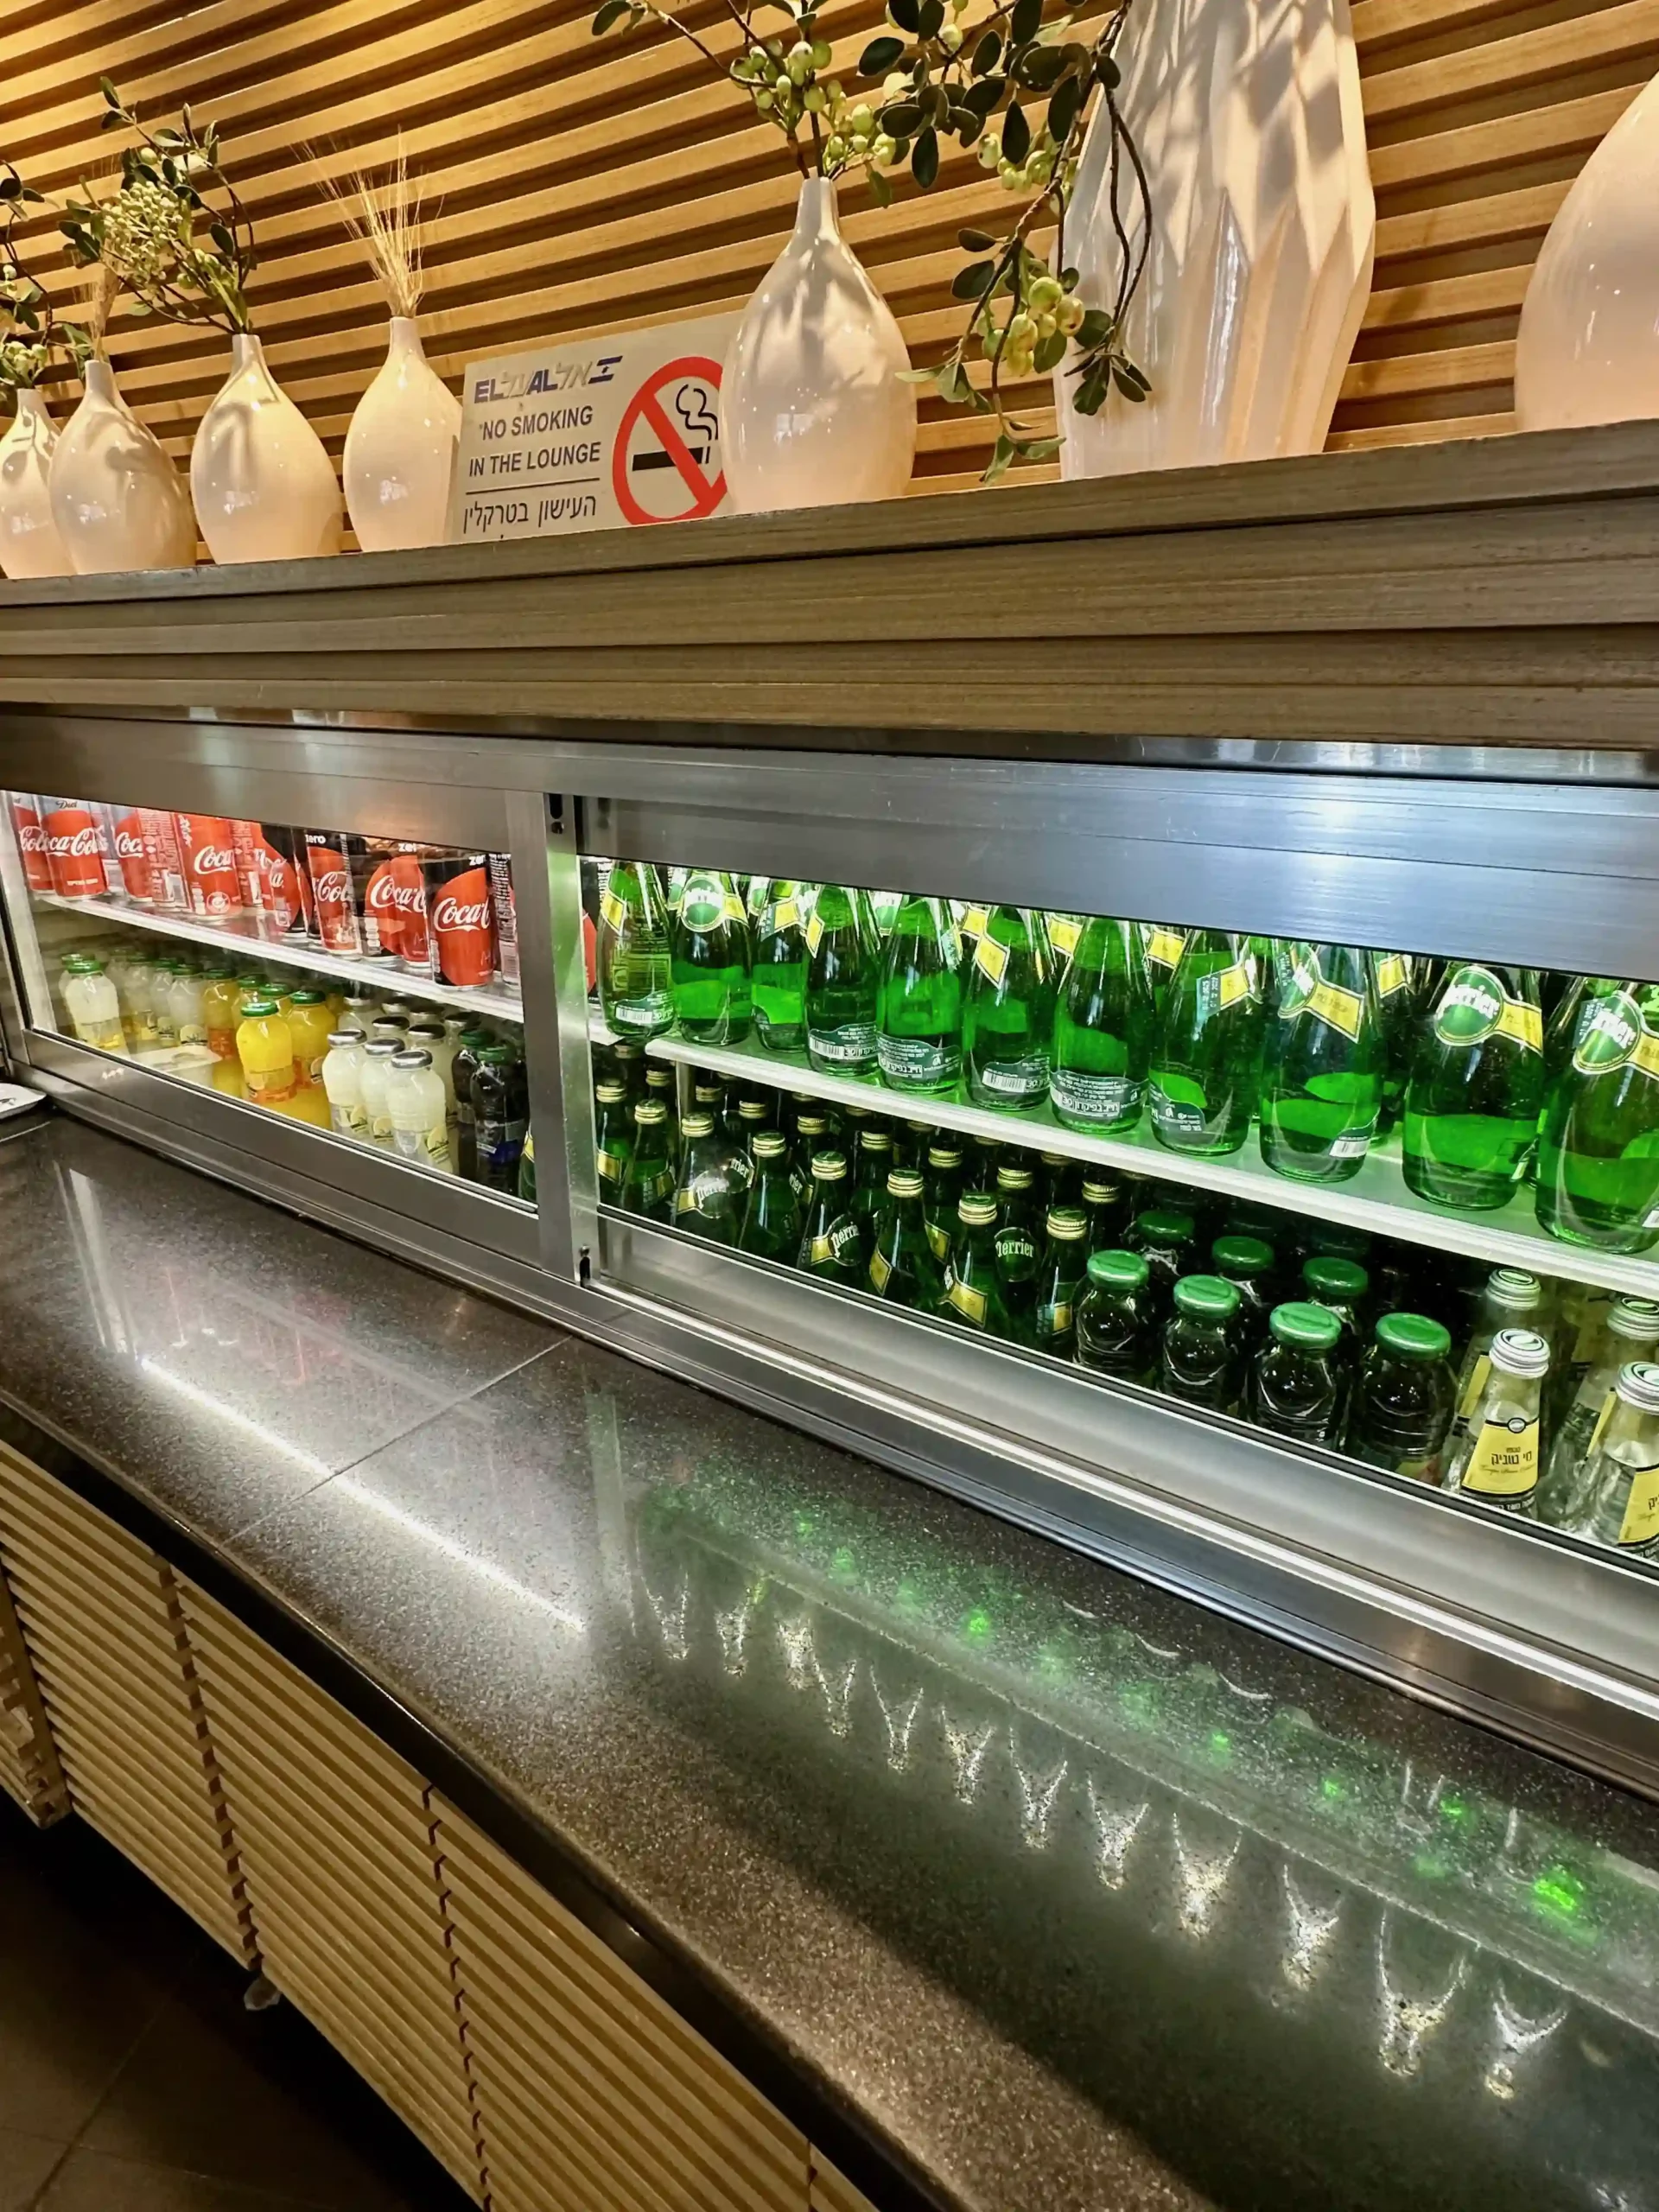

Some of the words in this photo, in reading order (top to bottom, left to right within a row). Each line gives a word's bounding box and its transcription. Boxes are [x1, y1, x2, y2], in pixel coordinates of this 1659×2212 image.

[483, 419, 506, 441] NO
[511, 404, 594, 436] SMOKING
[469, 457, 485, 477] IN
[490, 452, 522, 474] THE
[526, 442, 601, 469] LOUNGE
[462, 501, 529, 534] בטרקלין
[538, 495, 597, 528] העישון
